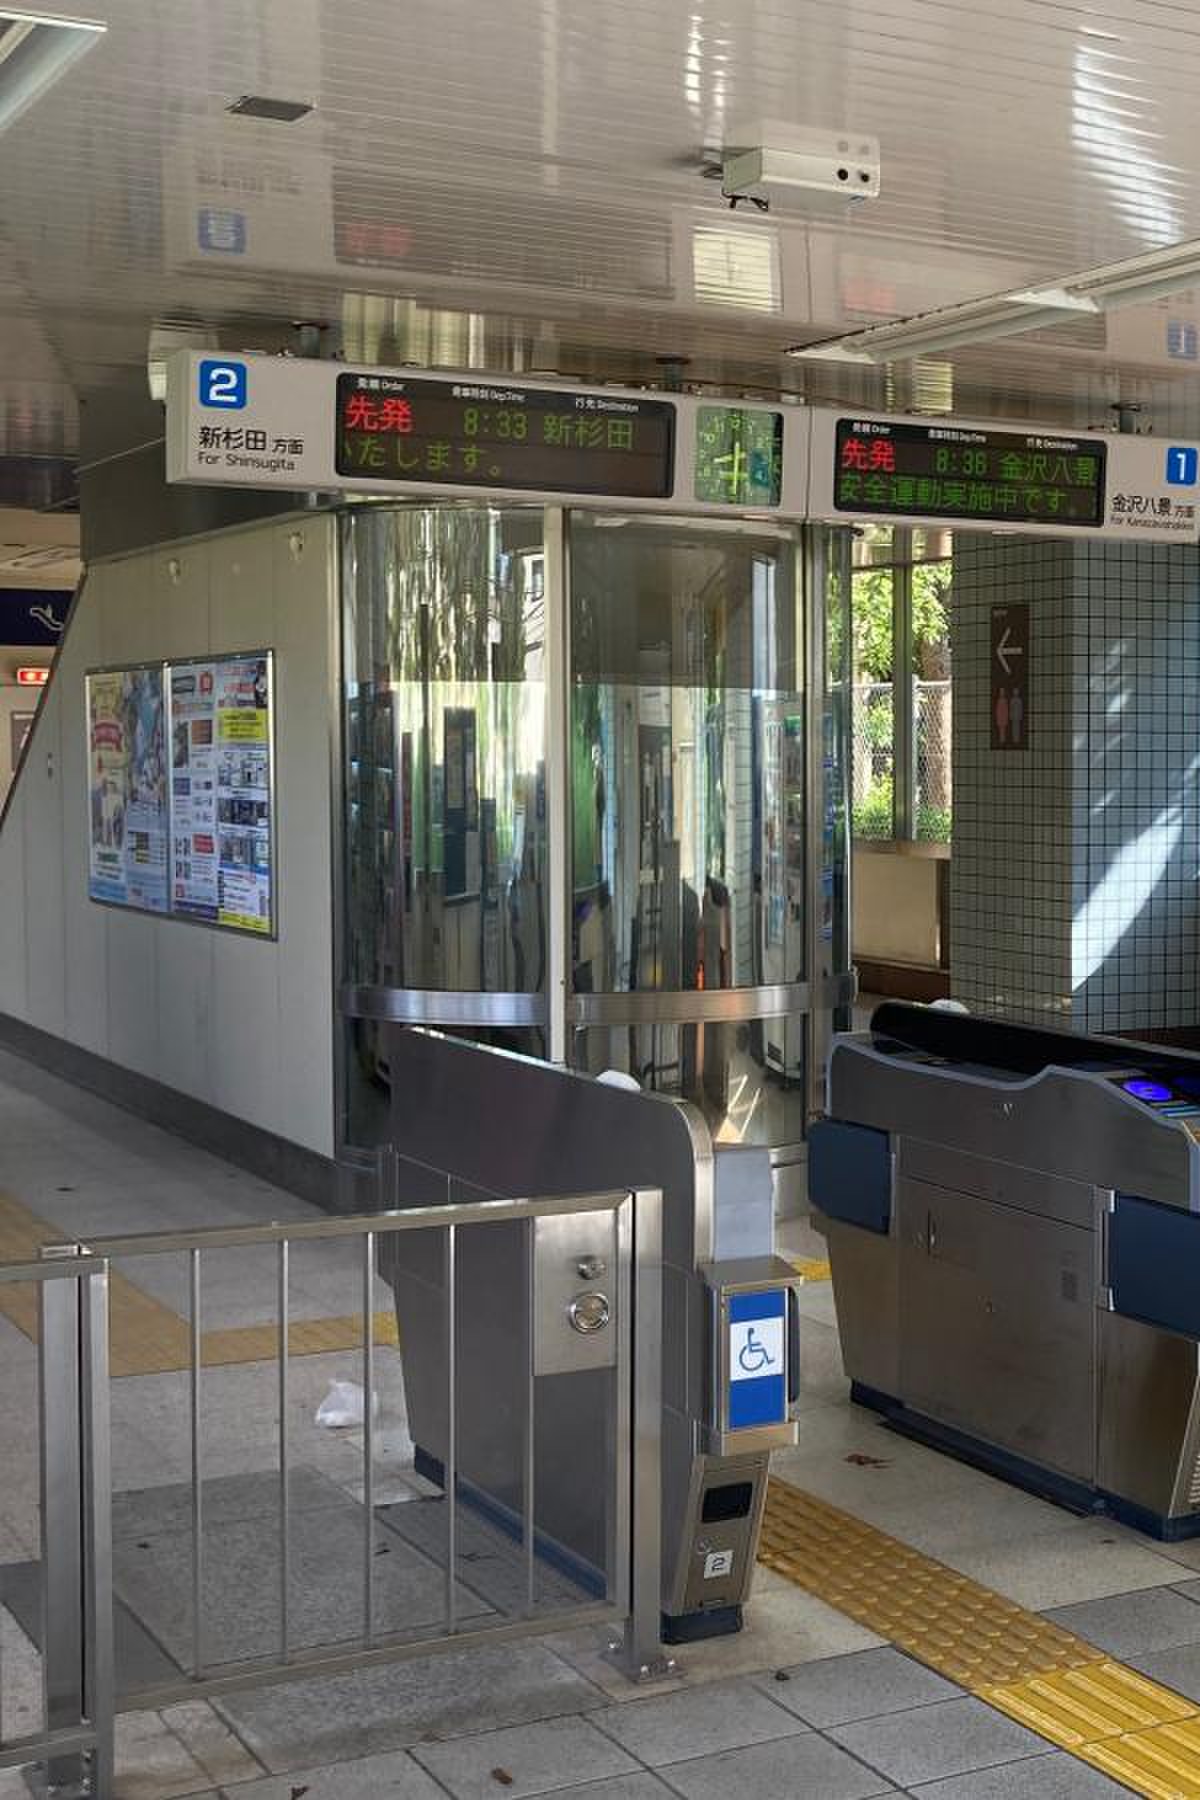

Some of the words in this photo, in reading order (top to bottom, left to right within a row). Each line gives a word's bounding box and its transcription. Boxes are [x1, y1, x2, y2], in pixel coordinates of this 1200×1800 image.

[209, 367, 238, 402] 2
[345, 395, 412, 433] 先発
[464, 407, 528, 441] 8:33
[544, 413, 634, 450] 新杉田
[199, 426, 266, 451] 新杉田
[272, 438, 304, 455] 方面
[198, 451, 222, 465] For
[225, 454, 295, 472] Shinsugita
[842, 439, 896, 472] 先発
[999, 451, 1096, 486] 金沢八景
[1176, 453, 1187, 481] 1
[1112, 494, 1171, 517] 金沢八景
